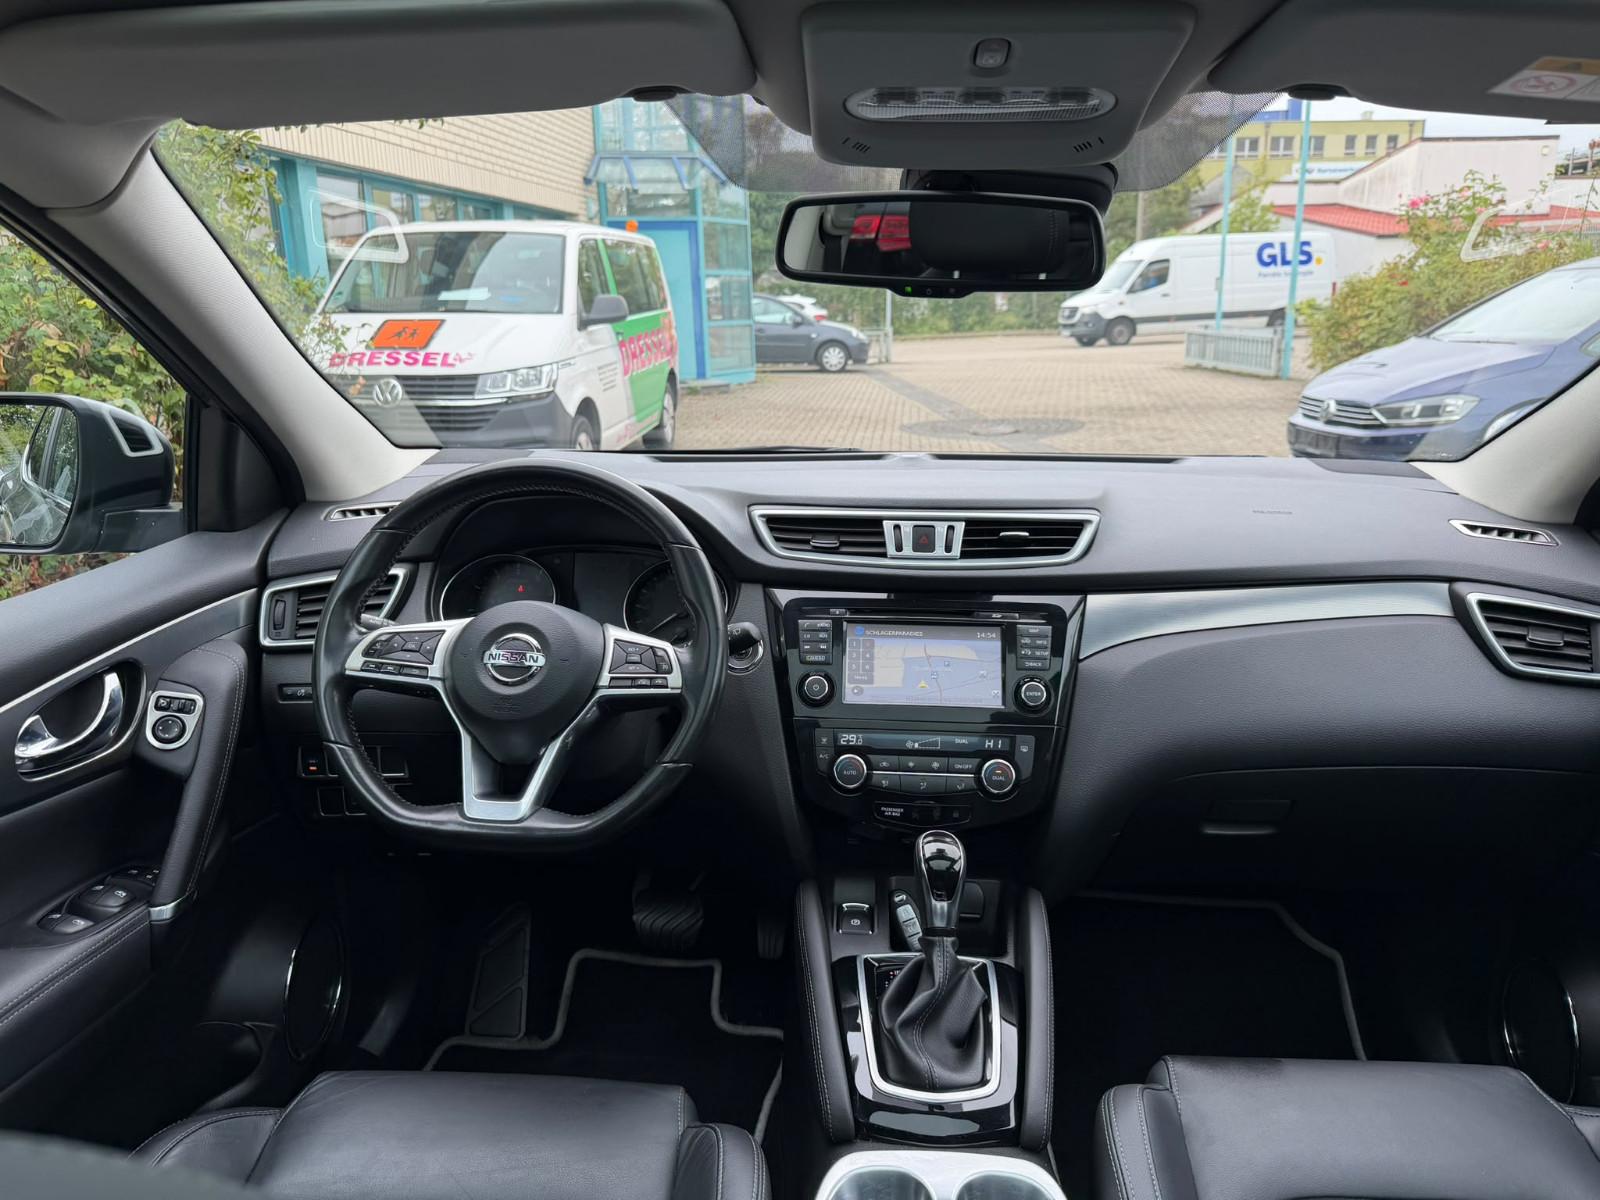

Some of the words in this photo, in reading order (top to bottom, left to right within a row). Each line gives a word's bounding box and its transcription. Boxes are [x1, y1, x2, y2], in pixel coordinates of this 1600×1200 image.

[328, 350, 456, 368] DRESSEL
[976, 631, 997, 639] 14:54
[488, 653, 539, 663] NISSAN
